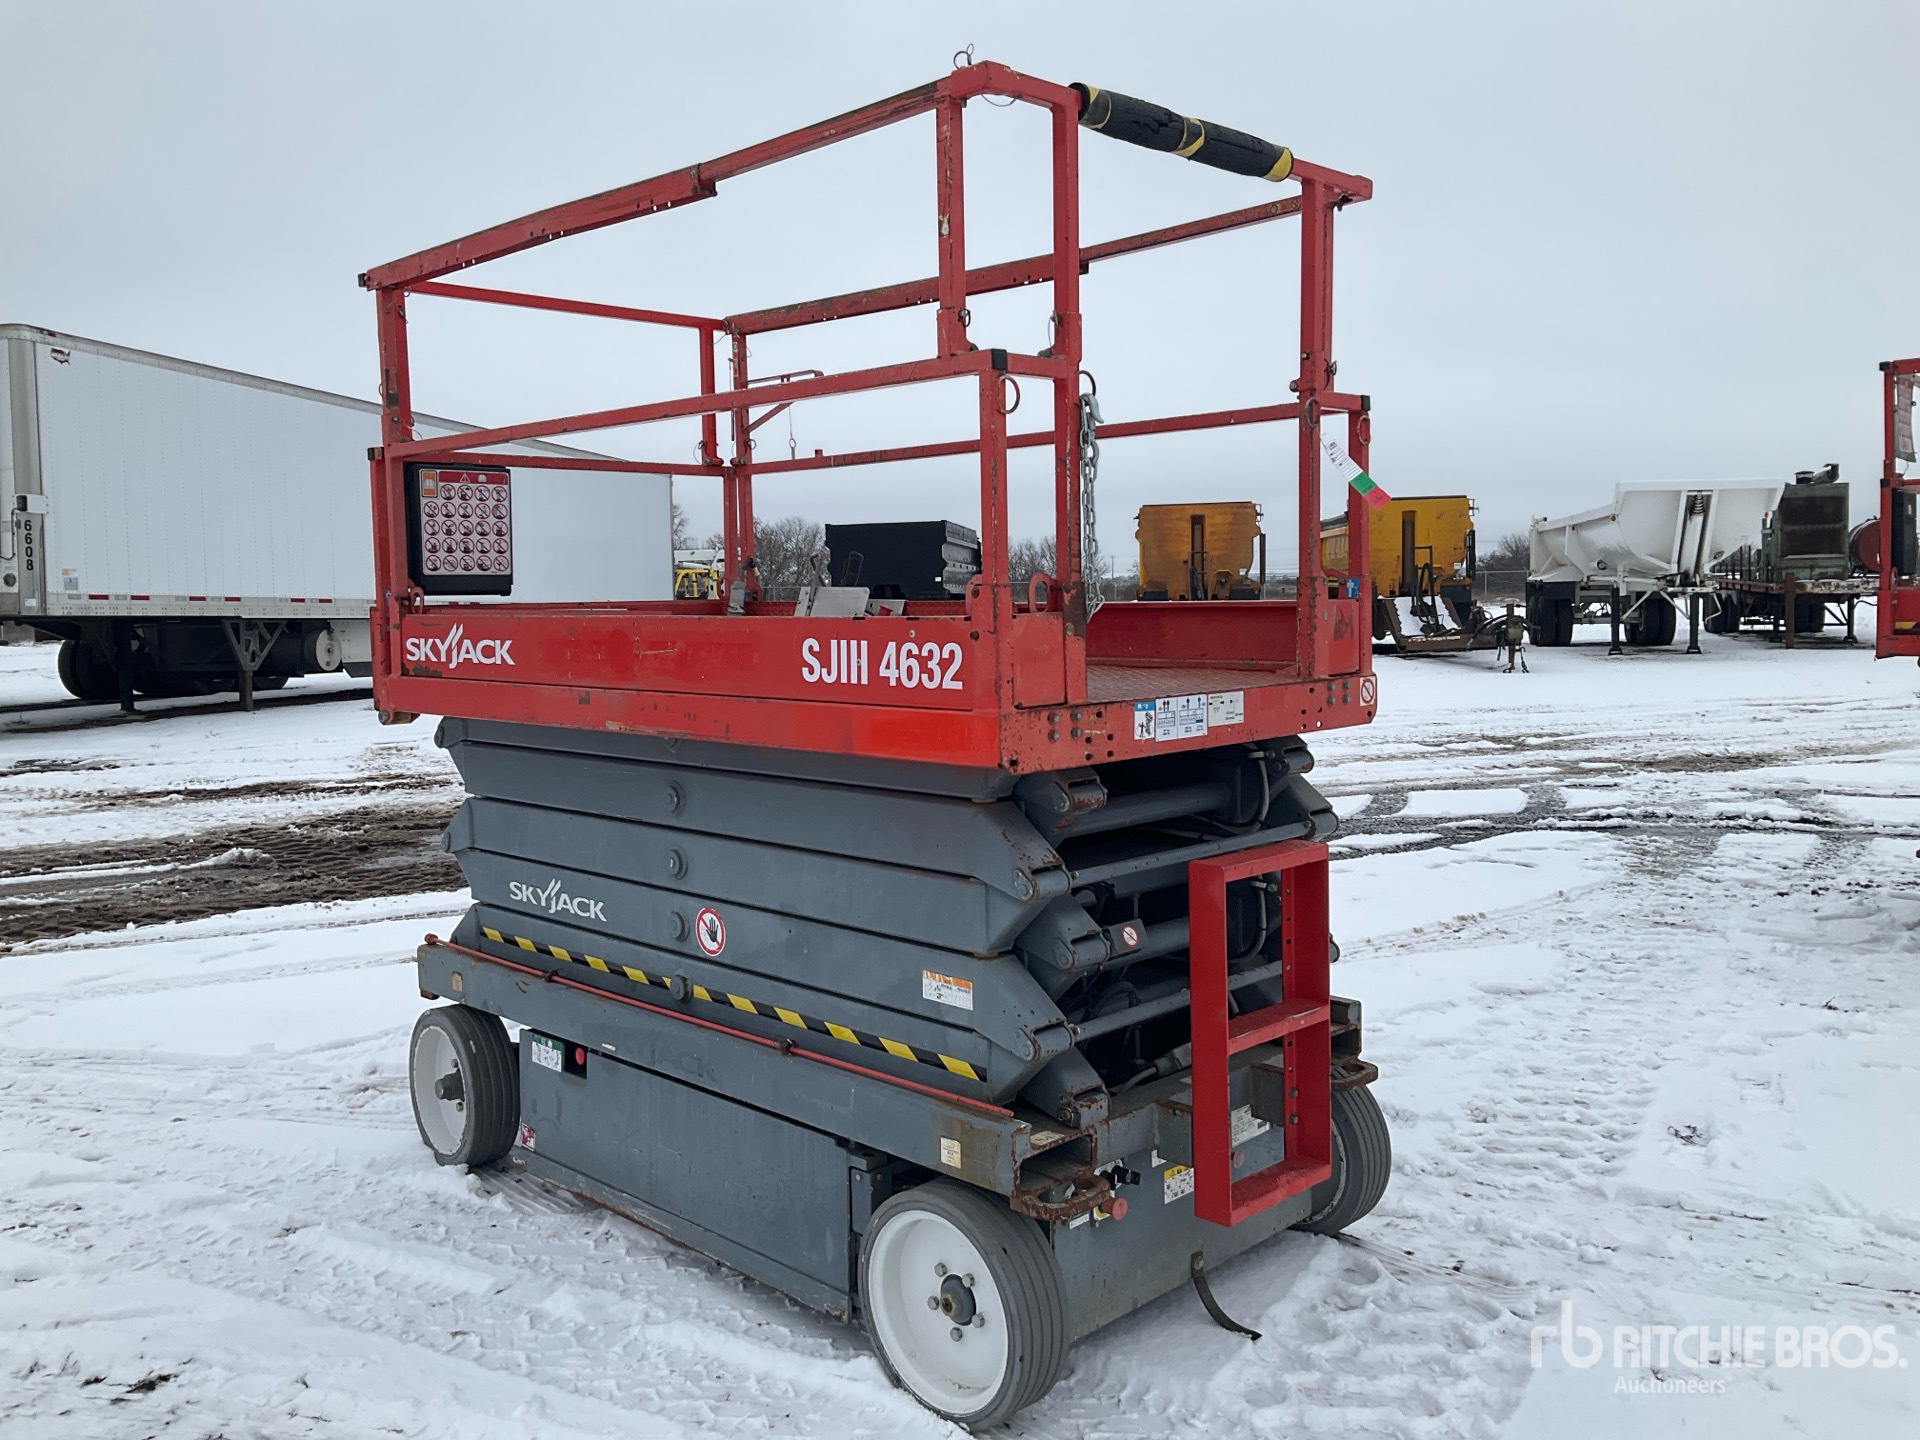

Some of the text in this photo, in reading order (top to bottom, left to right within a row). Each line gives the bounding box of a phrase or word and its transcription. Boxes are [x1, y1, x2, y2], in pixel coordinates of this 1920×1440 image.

[24, 519, 33, 571] 6608
[406, 623, 515, 669] SKYJACK
[802, 638, 963, 690] SJIII 4632
[509, 878, 607, 922] SKYJACK
